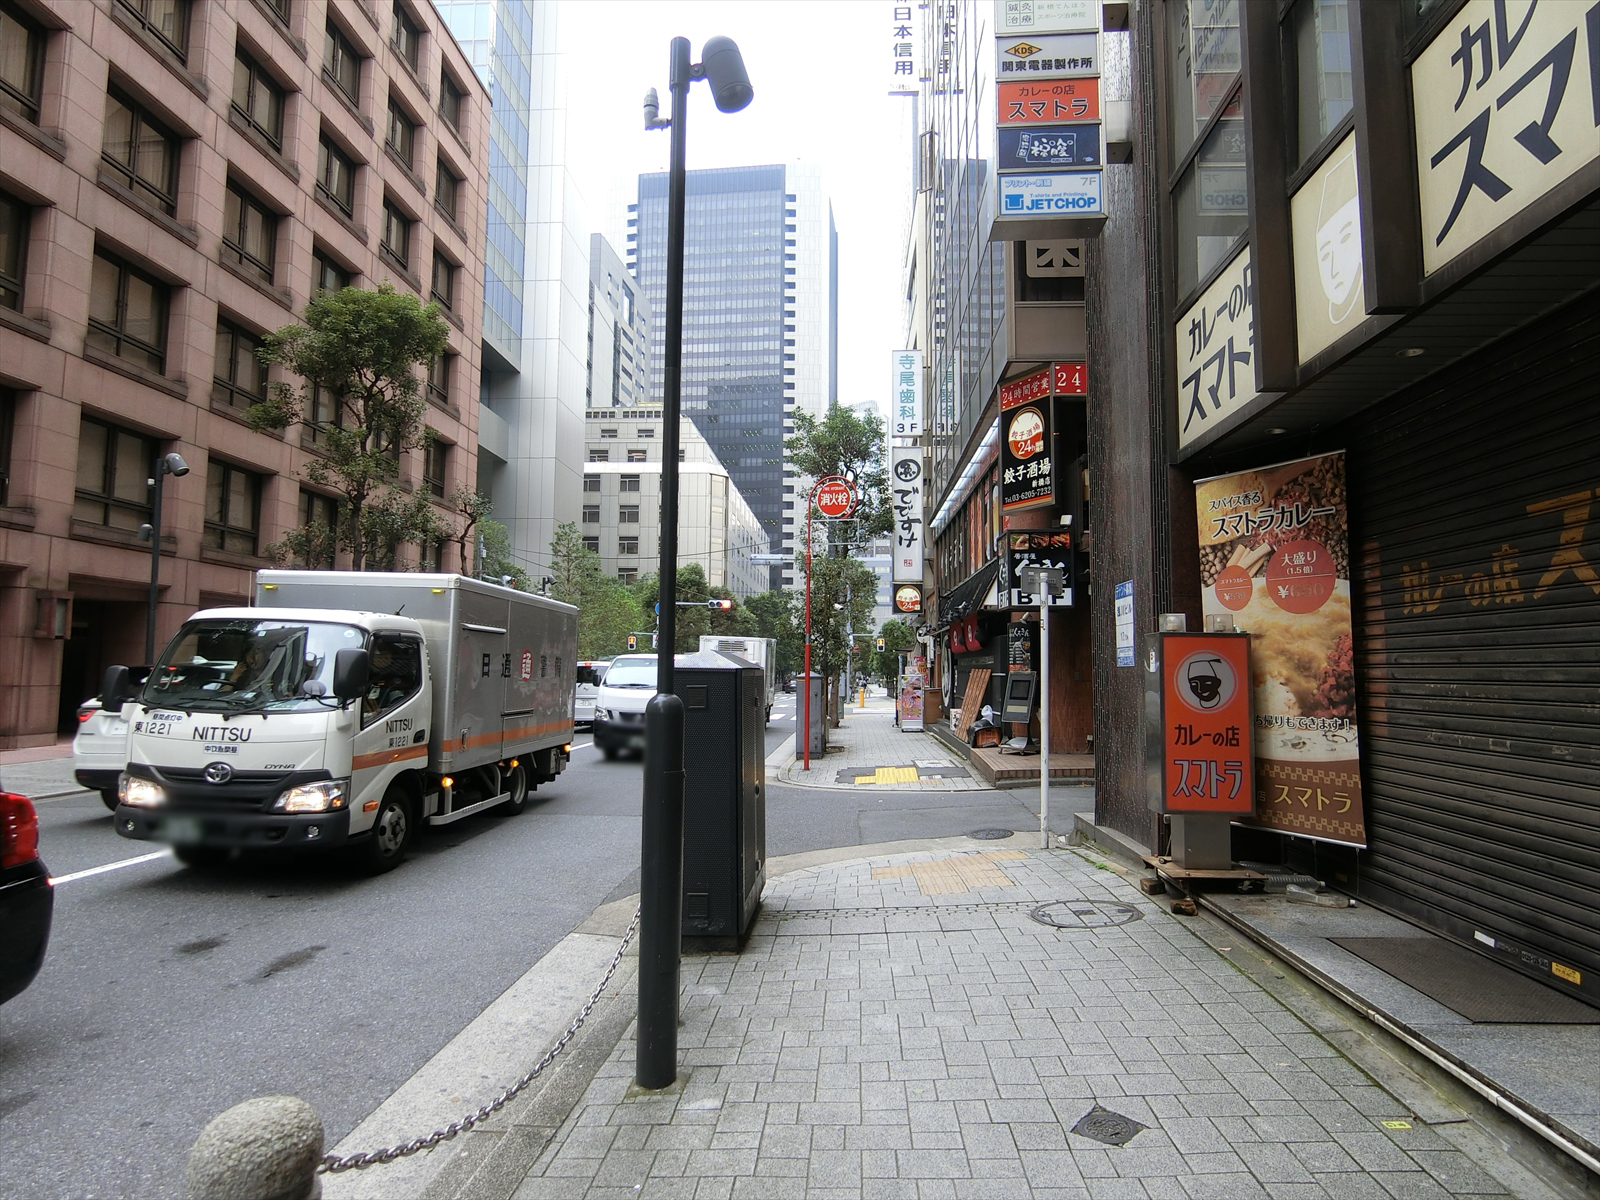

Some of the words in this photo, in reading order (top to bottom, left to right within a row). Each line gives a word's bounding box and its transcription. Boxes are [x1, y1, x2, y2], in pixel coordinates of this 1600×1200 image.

[893, 0, 913, 75] 日本信用
[1013, 46, 1033, 55] KDS
[1002, 57, 1093, 72] 関東電器製作所
[1019, 85, 1075, 97] カレーの店
[1008, 99, 1089, 119] スマトラ
[1431, 3, 1600, 248] スマ
[1080, 177, 1096, 186] 7F
[1026, 197, 1097, 210] JETCHOP
[899, 354, 915, 420] 寺尾歯科
[1057, 372, 1081, 387] 24
[1182, 321, 1254, 434] スマト
[1002, 377, 1049, 404] 24時間営業
[1003, 457, 1052, 485] 餃子酒場
[820, 491, 849, 506] 消火栓
[1208, 491, 1261, 512] スパイス香る
[1212, 502, 1336, 539] スマトラカレー
[1526, 487, 1600, 600] ス
[1281, 550, 1317, 567] 大盛り
[134, 721, 172, 736] 東1221
[193, 726, 252, 742] NITTSU
[386, 718, 413, 733] NITTSU
[1174, 724, 1240, 747] カレーの店
[1172, 759, 1243, 800] スマトラ
[1274, 784, 1352, 814] スマトラ
